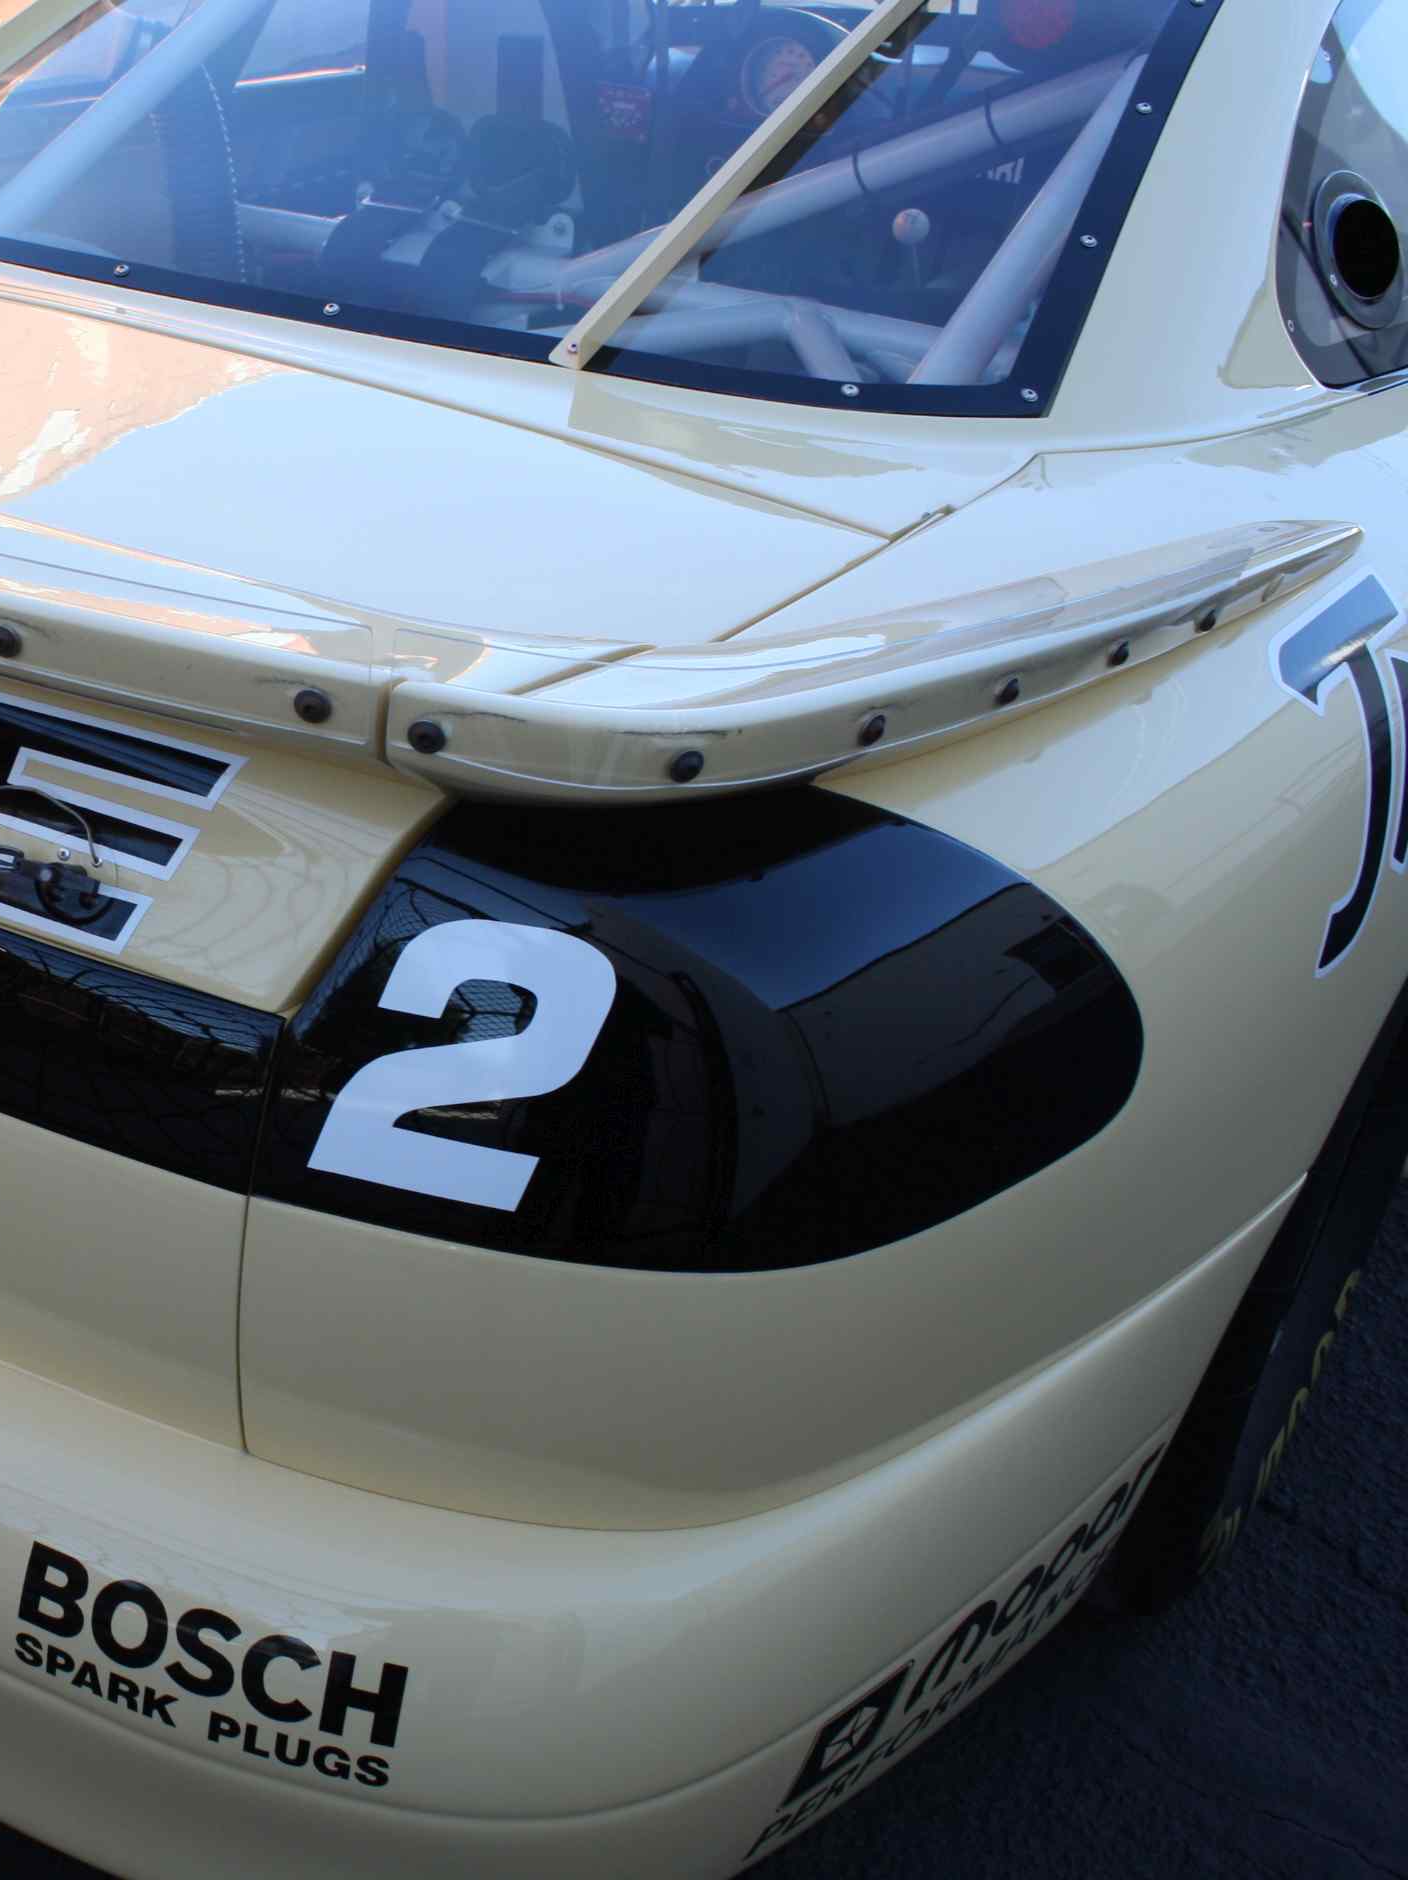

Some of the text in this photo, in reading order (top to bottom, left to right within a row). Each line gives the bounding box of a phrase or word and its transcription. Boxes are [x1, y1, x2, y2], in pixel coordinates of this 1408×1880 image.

[306, 918, 617, 1212] 2
[14, 1632, 390, 1787] SPARK PLUGS
[17, 1540, 409, 1748] BOSCH
